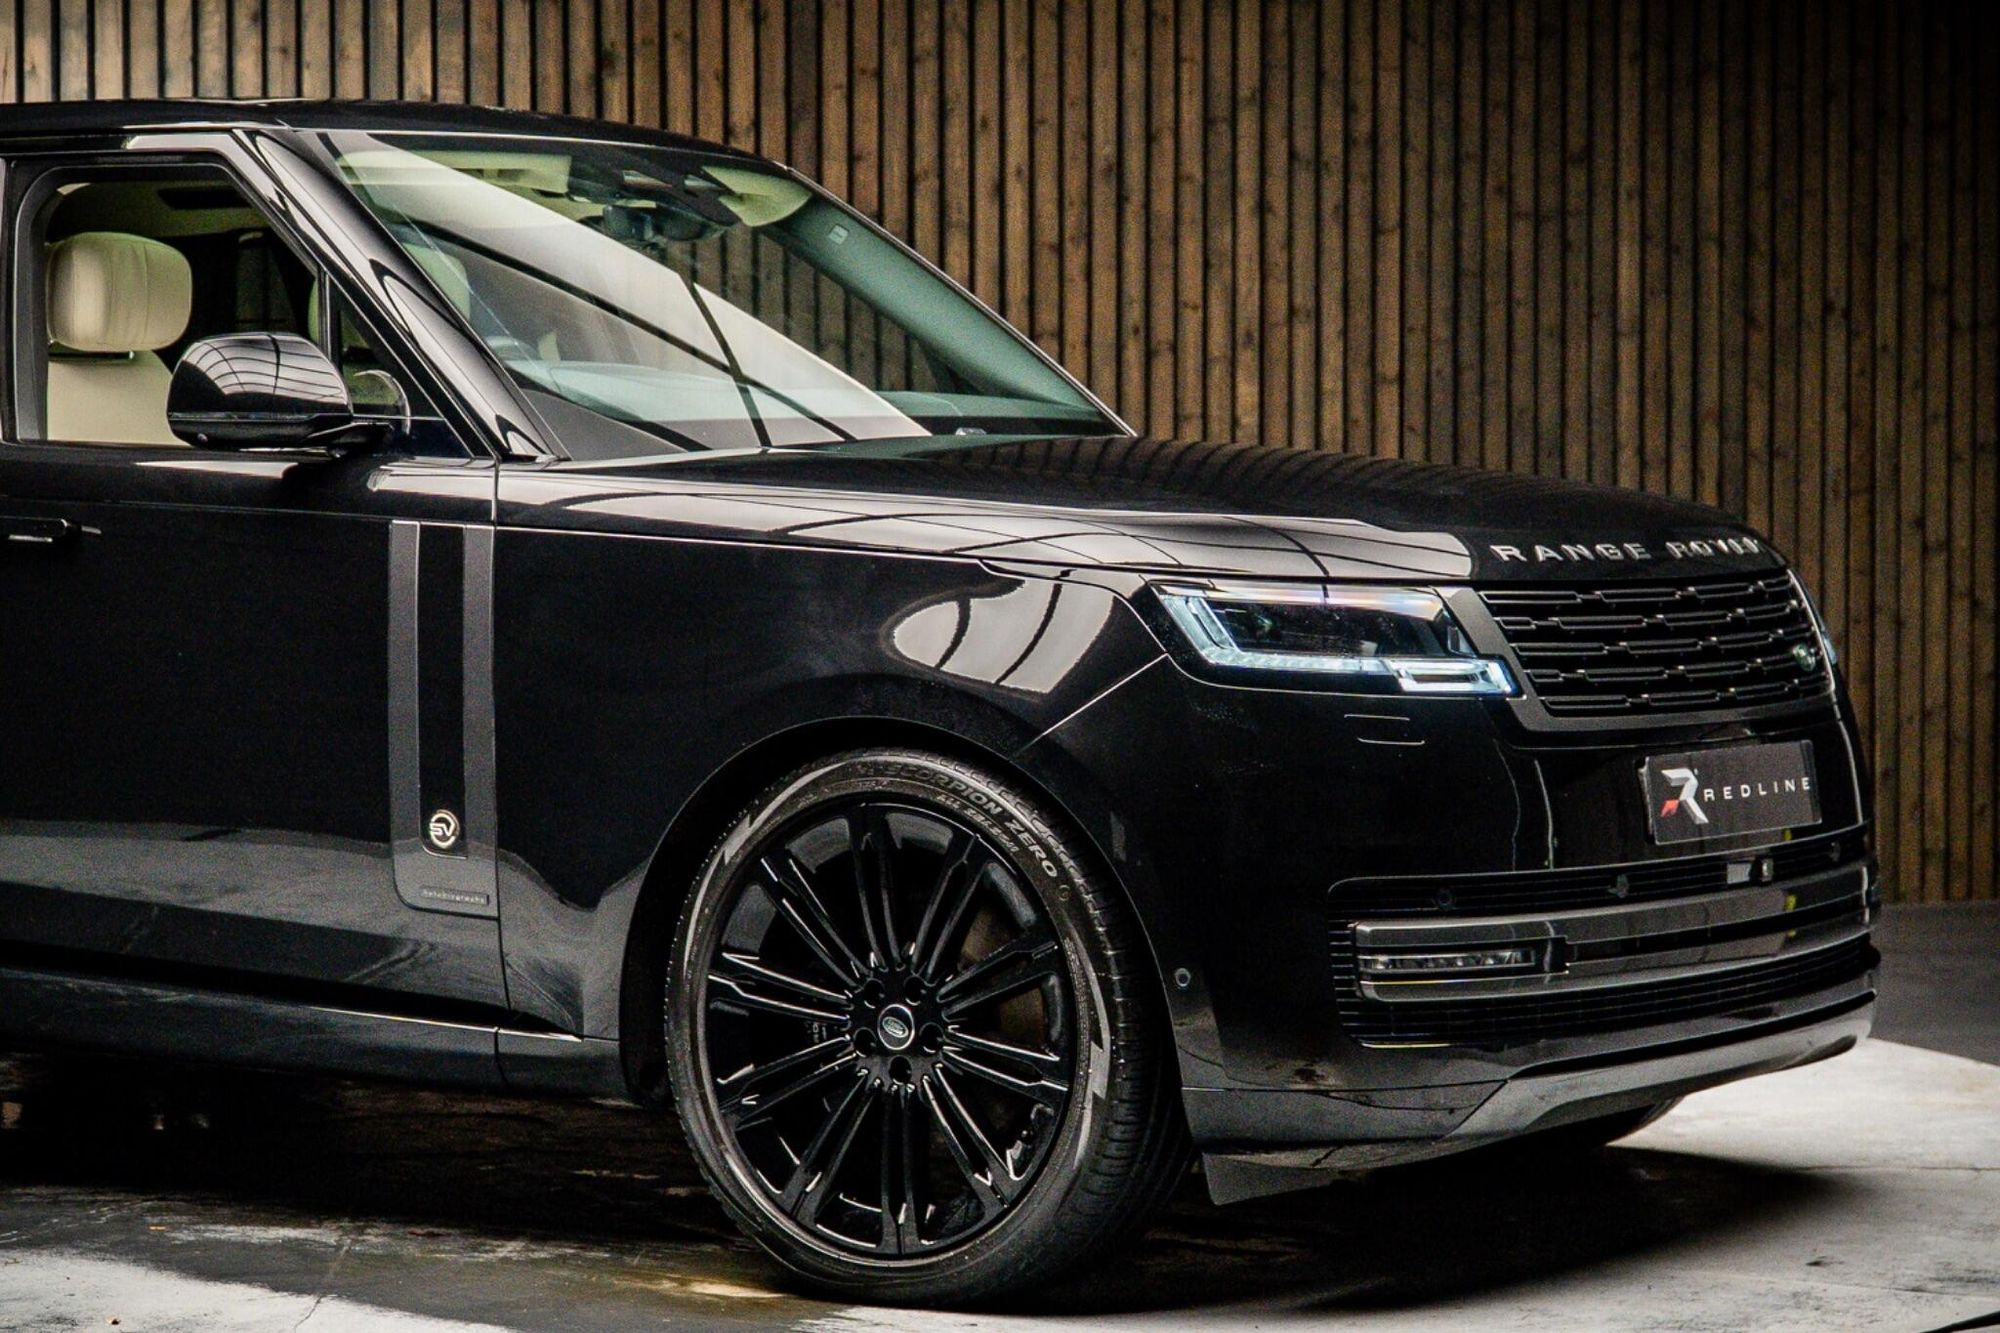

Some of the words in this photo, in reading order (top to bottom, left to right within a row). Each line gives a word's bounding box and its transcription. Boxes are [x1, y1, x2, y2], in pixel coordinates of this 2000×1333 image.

[1489, 544, 1651, 562] RANGE
[1703, 777, 1811, 802] REDLINE
[885, 764, 1003, 816] SCORPION
[1003, 818, 1058, 877] ZERO
